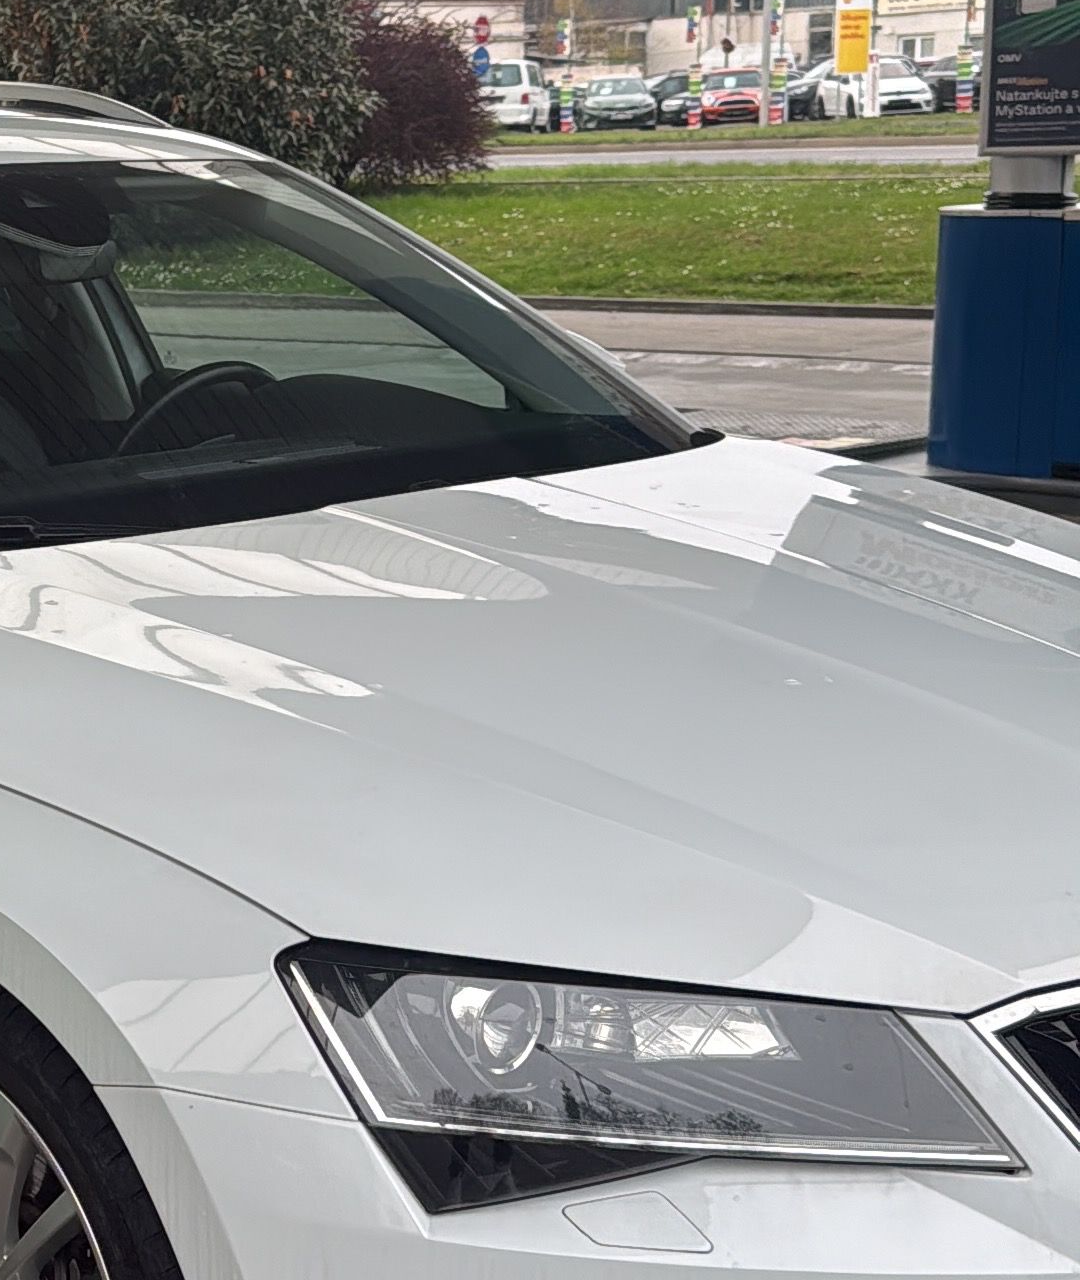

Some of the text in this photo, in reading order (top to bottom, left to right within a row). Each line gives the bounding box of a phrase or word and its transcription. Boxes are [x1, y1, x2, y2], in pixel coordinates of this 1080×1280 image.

[996, 88, 1079, 102] Natankujte s
[995, 104, 1063, 119] MyStation
[1065, 104, 1074, 114] a
